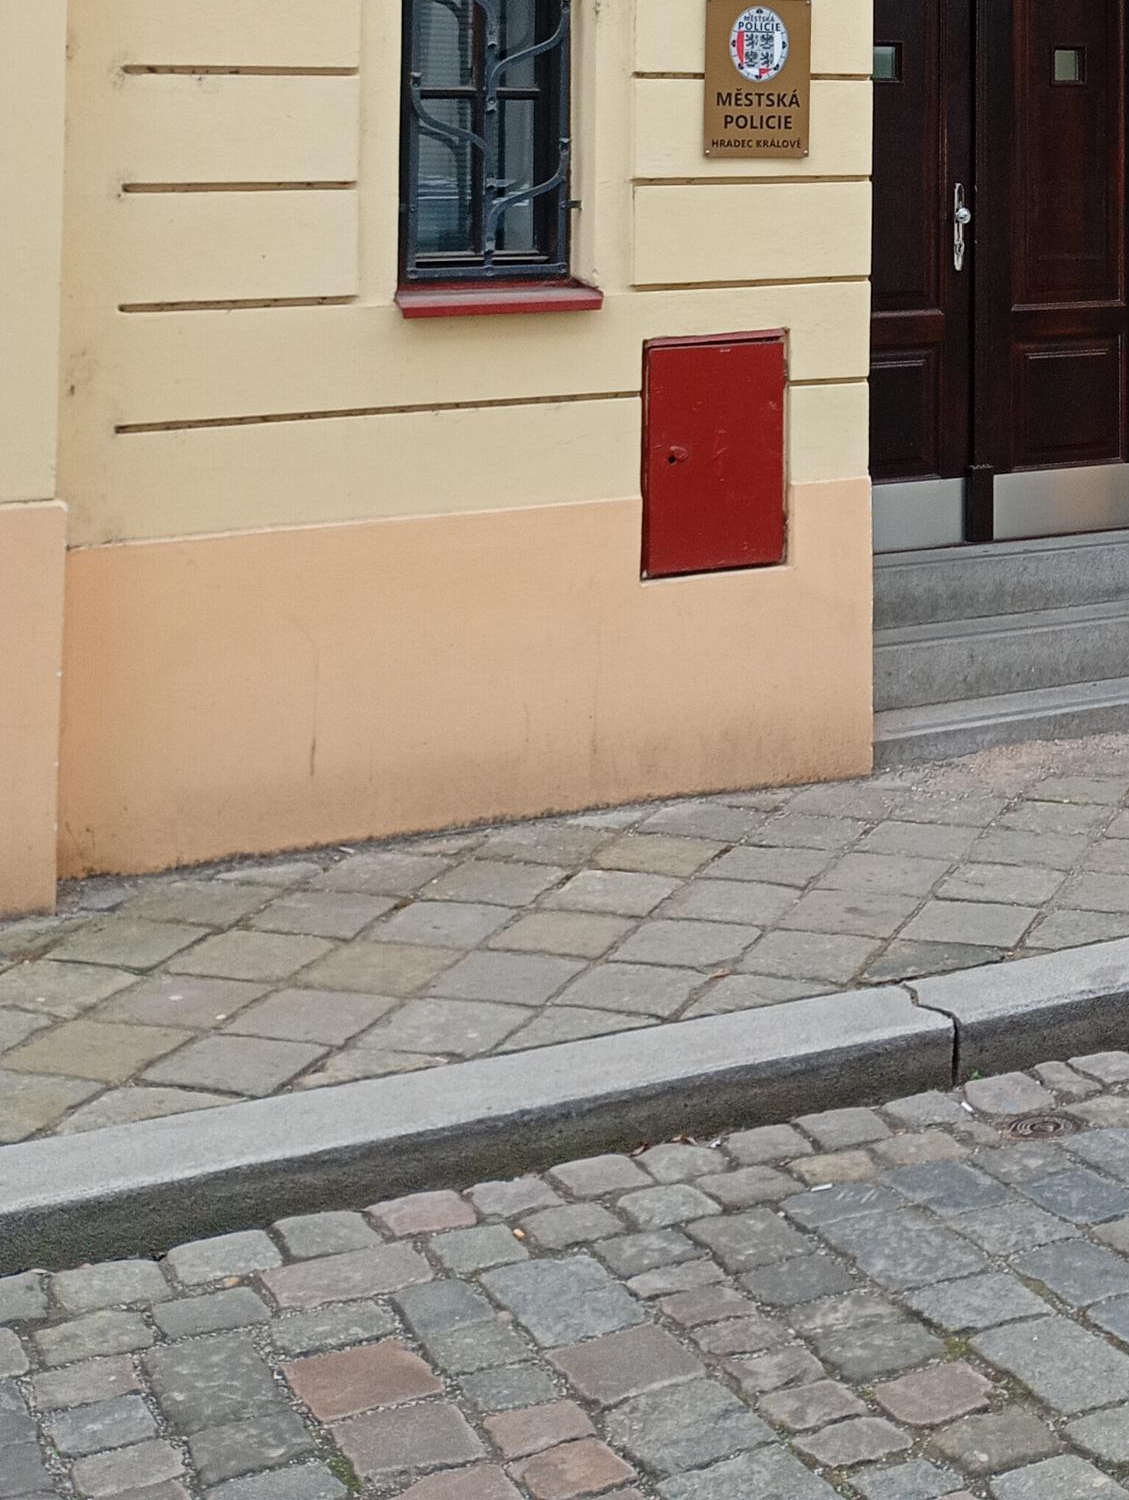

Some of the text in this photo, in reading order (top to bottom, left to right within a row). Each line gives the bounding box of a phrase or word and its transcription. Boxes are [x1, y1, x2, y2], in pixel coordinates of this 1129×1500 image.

[738, 21, 781, 31] POLICIE
[716, 88, 800, 108] MĚSTSKÁ
[723, 114, 793, 130] POLICIE
[711, 137, 801, 149] HRADEC KRÁLOVÉ
